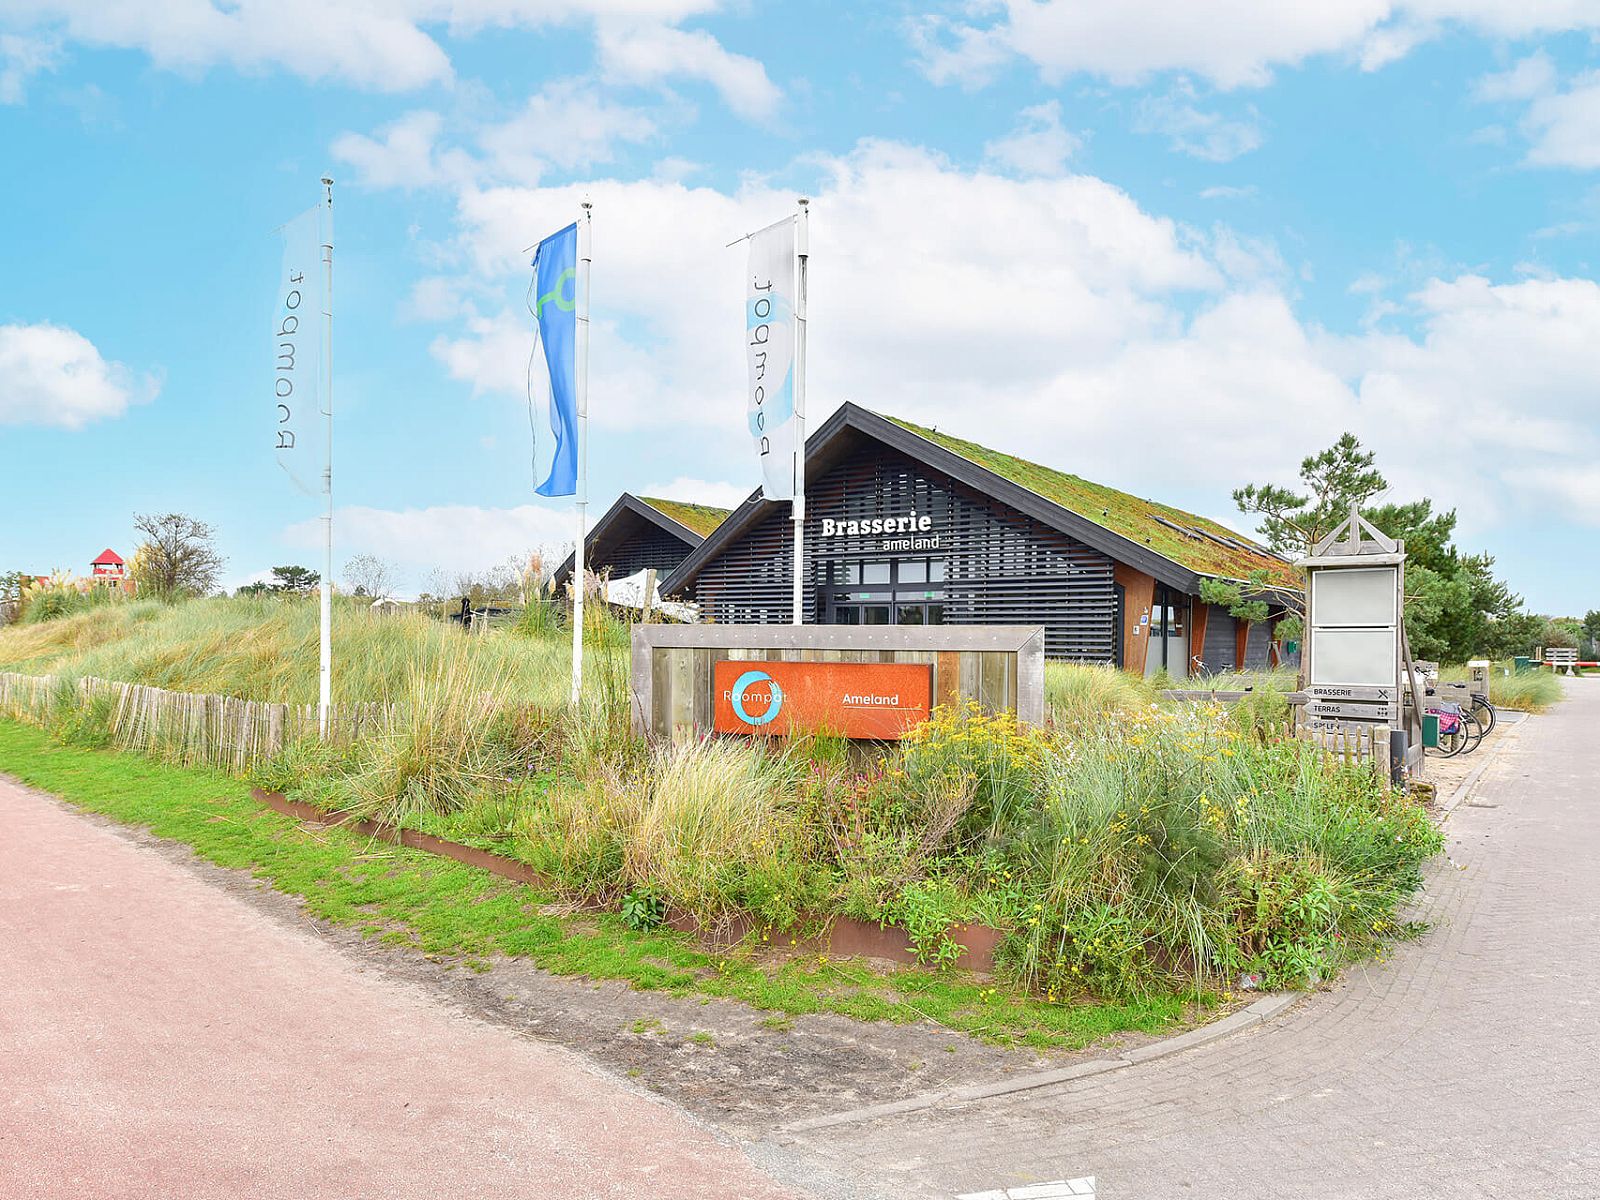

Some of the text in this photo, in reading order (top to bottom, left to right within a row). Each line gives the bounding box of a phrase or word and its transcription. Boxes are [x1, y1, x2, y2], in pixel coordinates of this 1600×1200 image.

[821, 510, 932, 537] Brasserie
[883, 535, 940, 551] ameland
[723, 690, 787, 704] Roompot
[842, 693, 899, 705] Ameland
[1313, 688, 1352, 697] BRASSERIE
[1313, 705, 1341, 713] TERRAS
